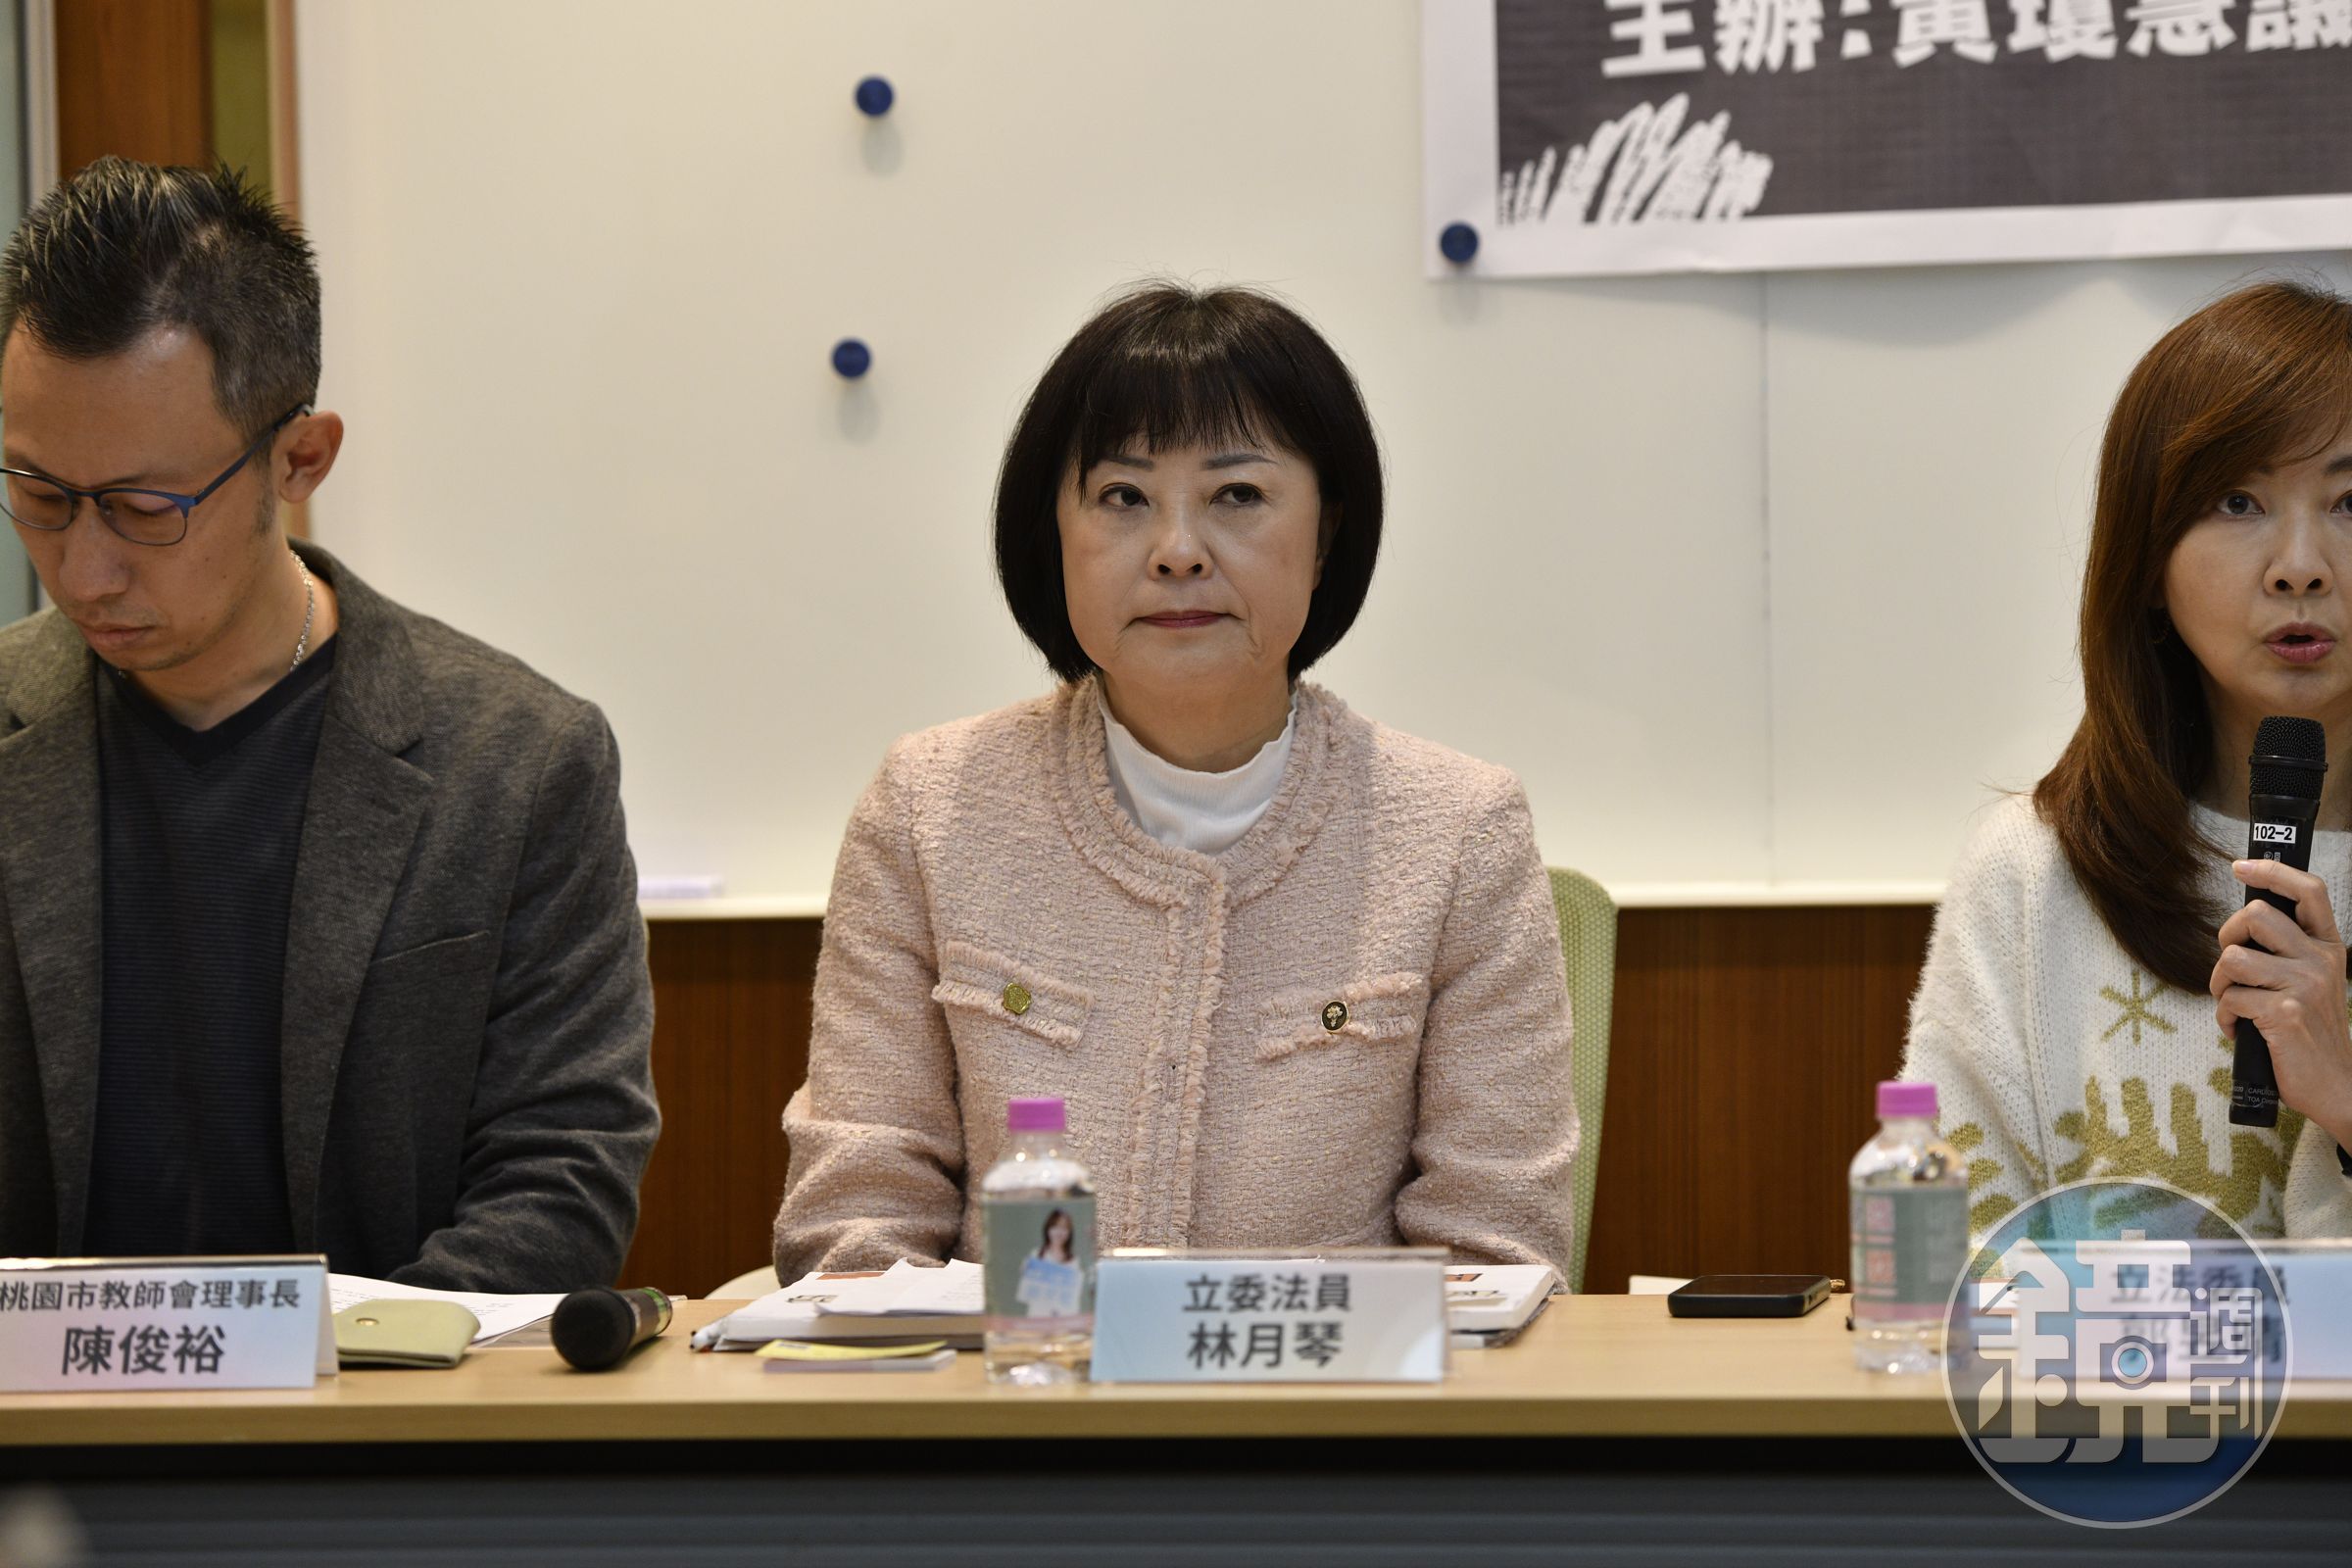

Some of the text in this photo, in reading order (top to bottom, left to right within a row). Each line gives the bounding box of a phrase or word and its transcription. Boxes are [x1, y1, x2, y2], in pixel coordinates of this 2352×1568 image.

[2255, 825, 2293, 841] 102-2
[0, 1279, 301, 1311] 桃園市教師會理事長
[1182, 1273, 1352, 1313] 立委法員
[61, 1324, 226, 1376] 陳俊裕
[1187, 1322, 1343, 1369] 林月琴
